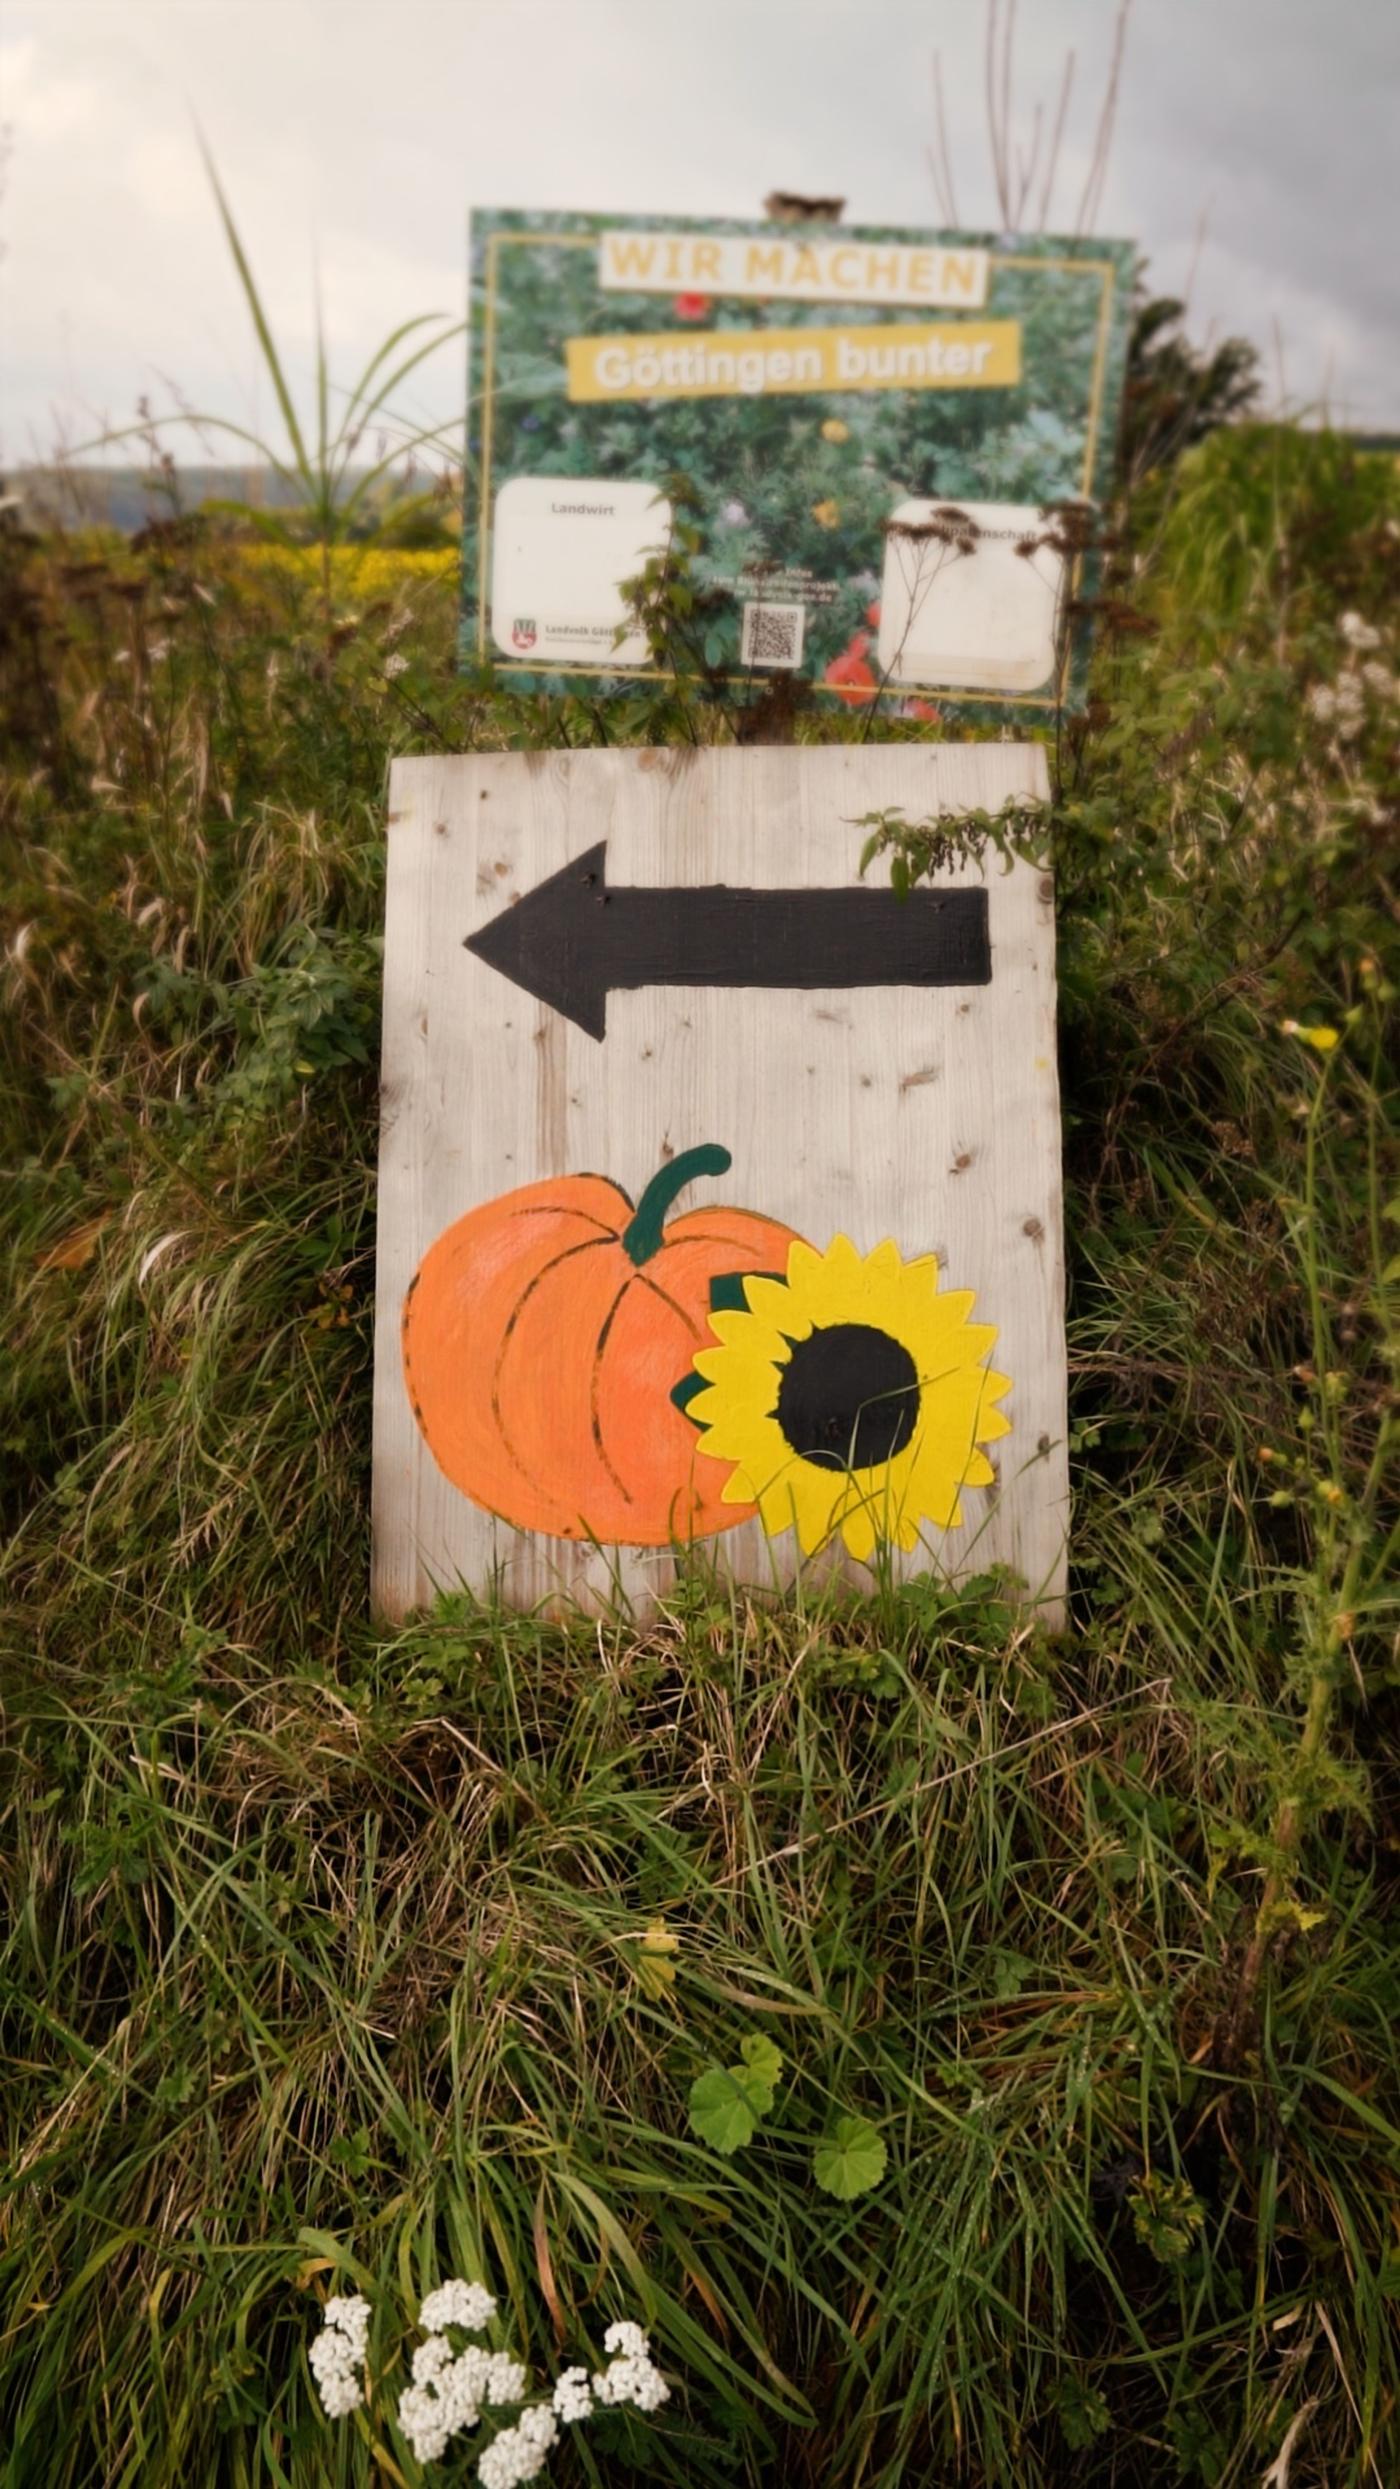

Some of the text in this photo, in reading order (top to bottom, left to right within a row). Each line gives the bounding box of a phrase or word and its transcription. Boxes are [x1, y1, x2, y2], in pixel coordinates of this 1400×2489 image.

[608, 238, 976, 294] WIR MACHEN
[595, 335, 992, 394] Göttingen bunter
[551, 502, 615, 516] Landwirt
[591, 628, 641, 640] Götten
